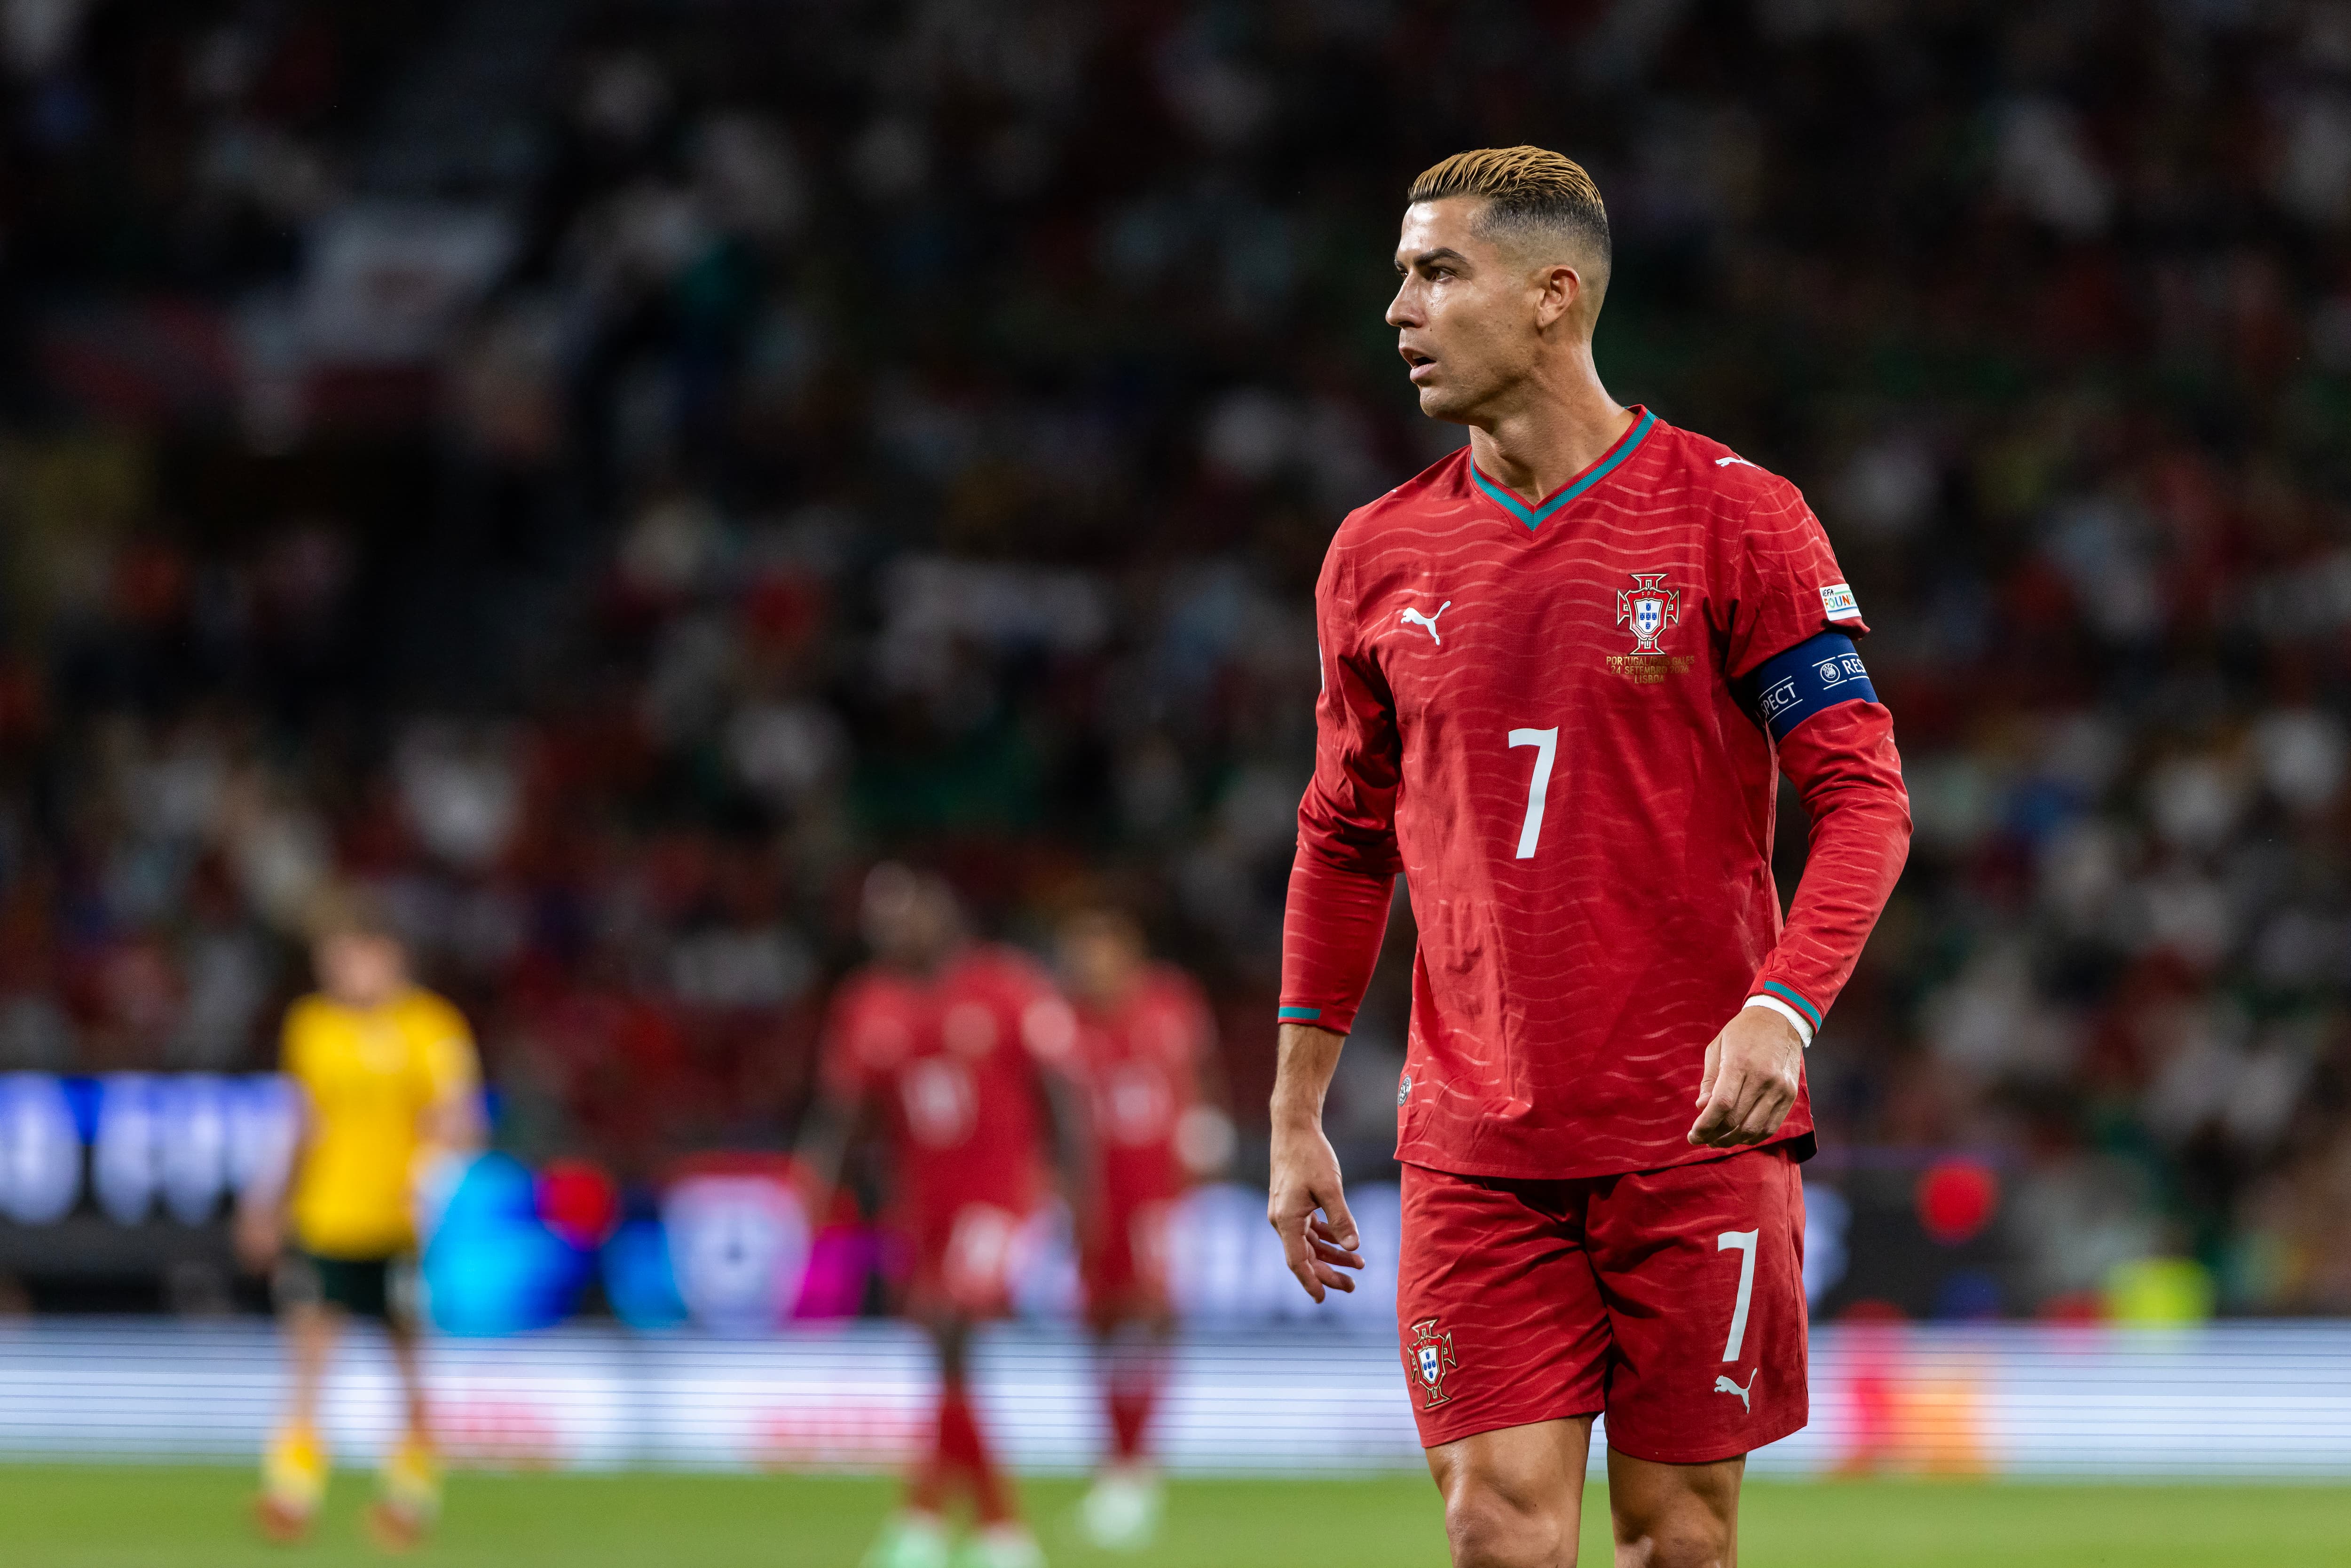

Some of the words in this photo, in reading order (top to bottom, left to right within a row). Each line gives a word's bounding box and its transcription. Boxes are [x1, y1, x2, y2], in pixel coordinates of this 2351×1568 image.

[1822, 588, 1834, 597] UEFA
[1824, 594, 1856, 609] FOUND
[1610, 665, 1621, 674] 24
[1625, 665, 1667, 675] SETEMBRO
[1842, 658, 1867, 674] RES
[1634, 675, 1664, 684] LISBOA
[1508, 726, 1559, 859] 7
[1718, 1228, 1759, 1363] 7
